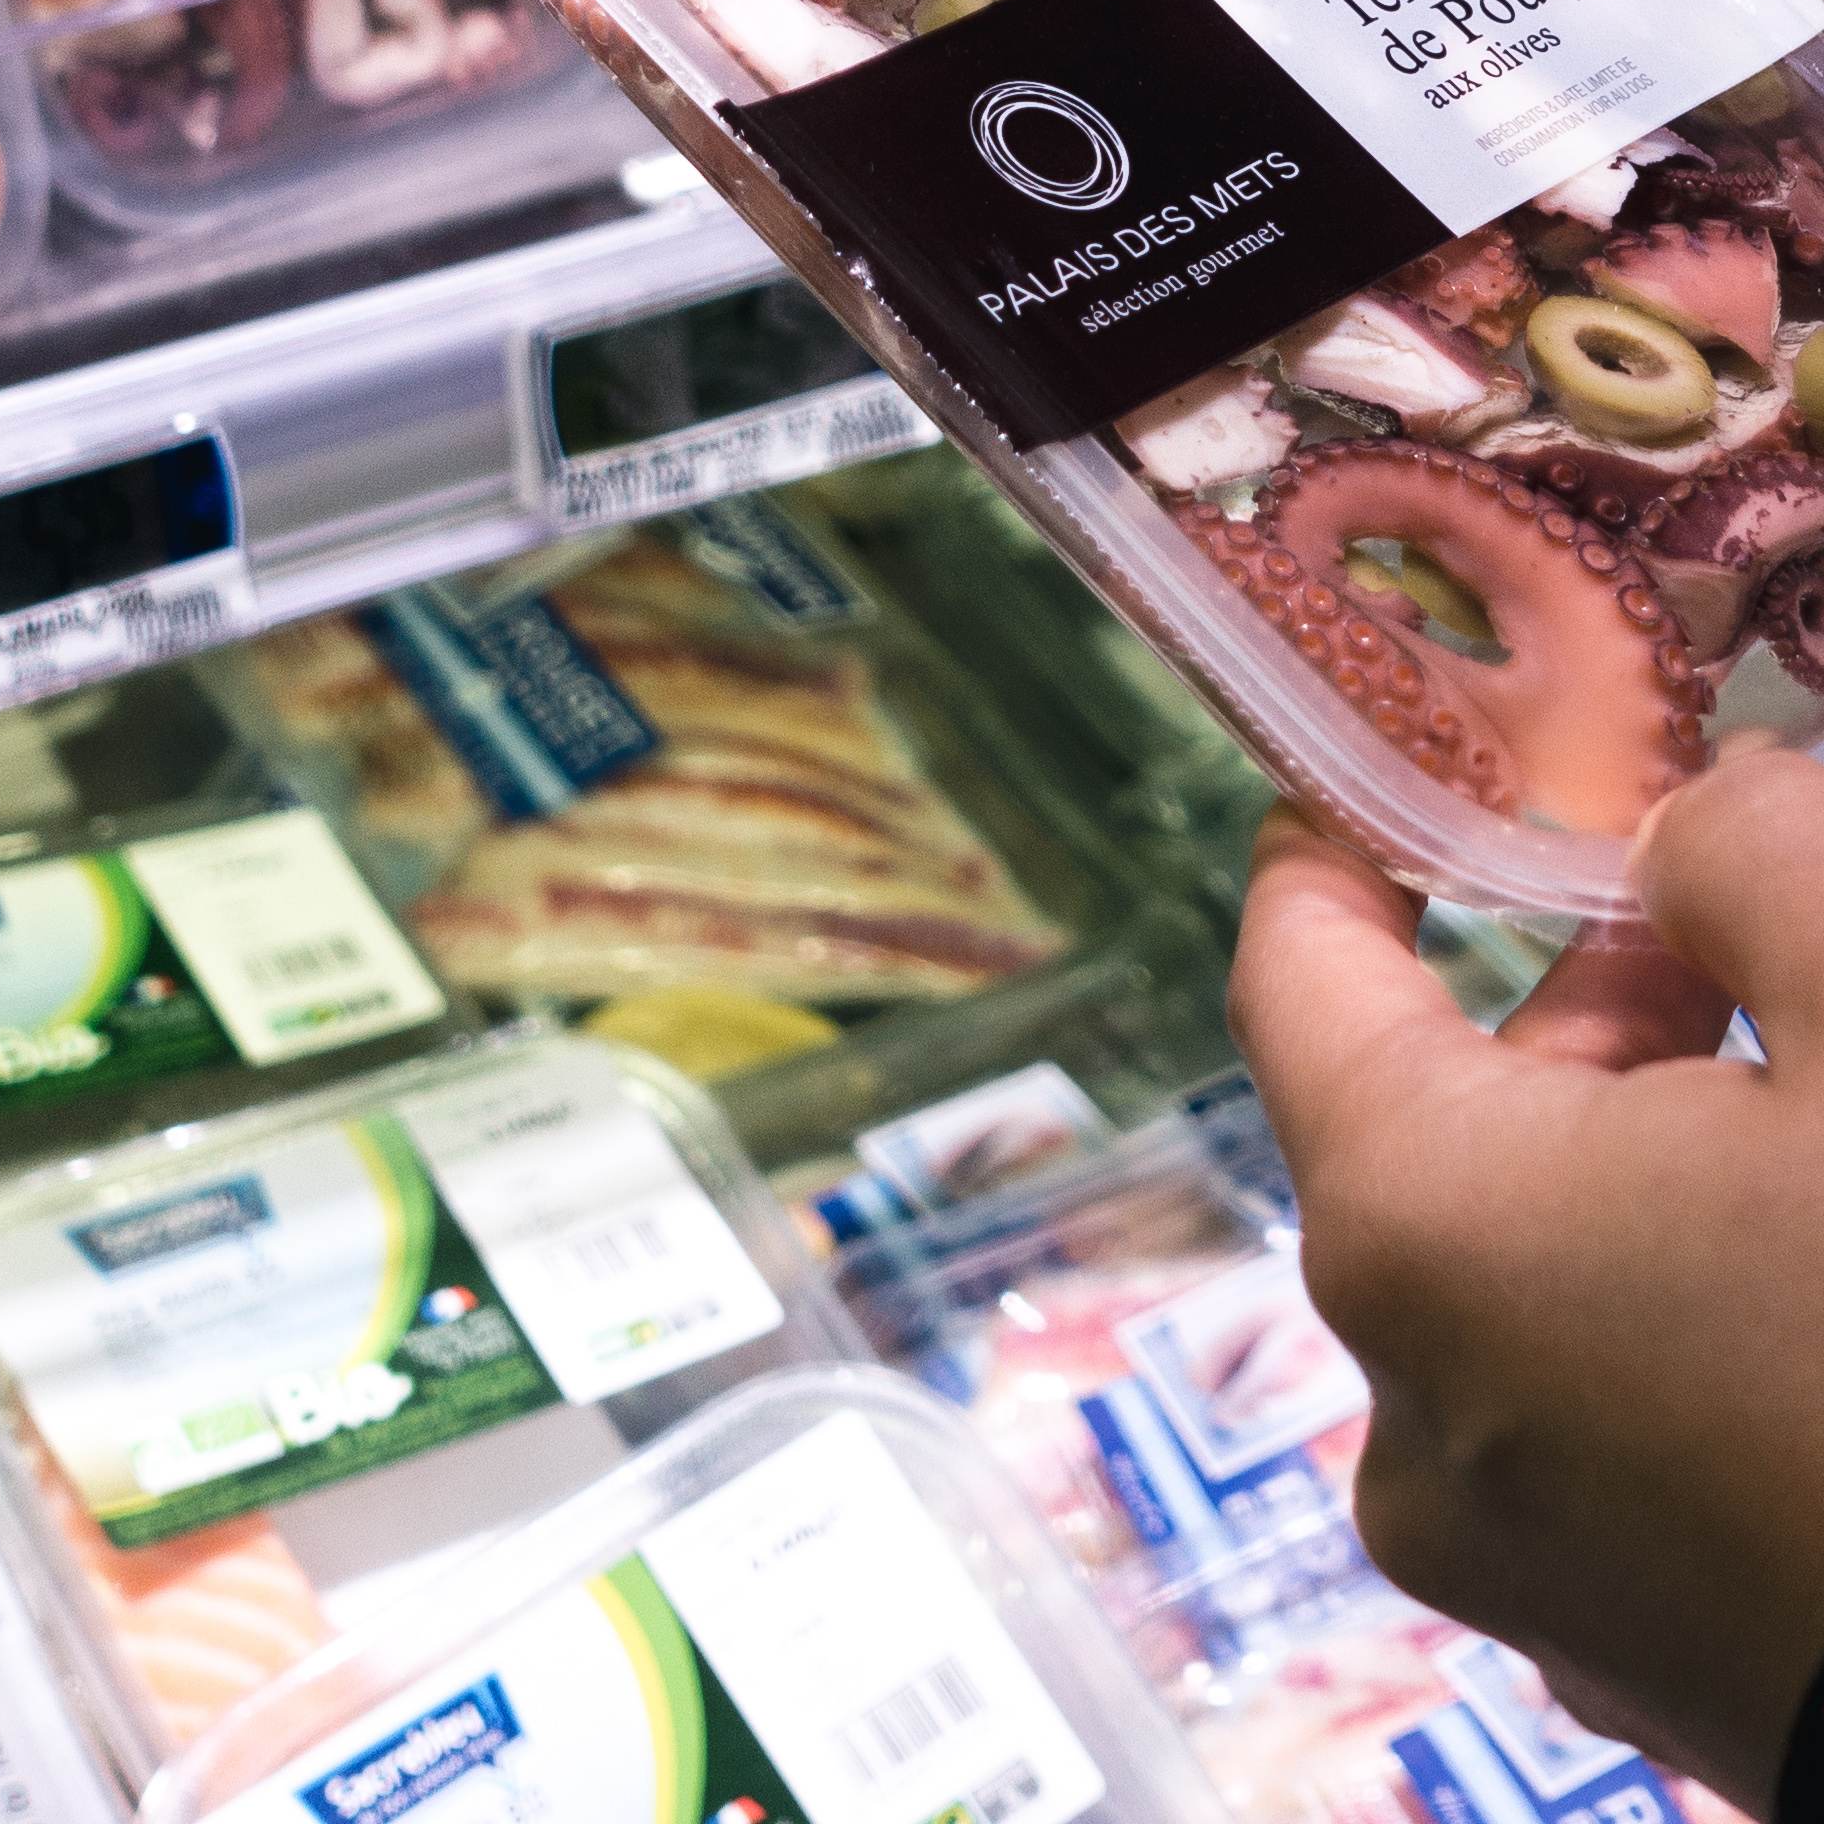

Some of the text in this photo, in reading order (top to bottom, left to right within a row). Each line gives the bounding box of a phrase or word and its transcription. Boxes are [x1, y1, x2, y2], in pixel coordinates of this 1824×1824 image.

[1382, 26, 1449, 77] de
[1423, 24, 1562, 110] aux olives
[1557, 86, 1588, 108] DATE
[1580, 66, 1618, 94] LIMITE
[1614, 56, 1638, 77] DE
[1493, 111, 1585, 167] CONSOMMATION
[1584, 93, 1617, 117] VOIR
[1611, 84, 1634, 106] AU
[977, 149, 1302, 326] PALAIS DES METS
[1079, 217, 1287, 335] sélection gourmet
